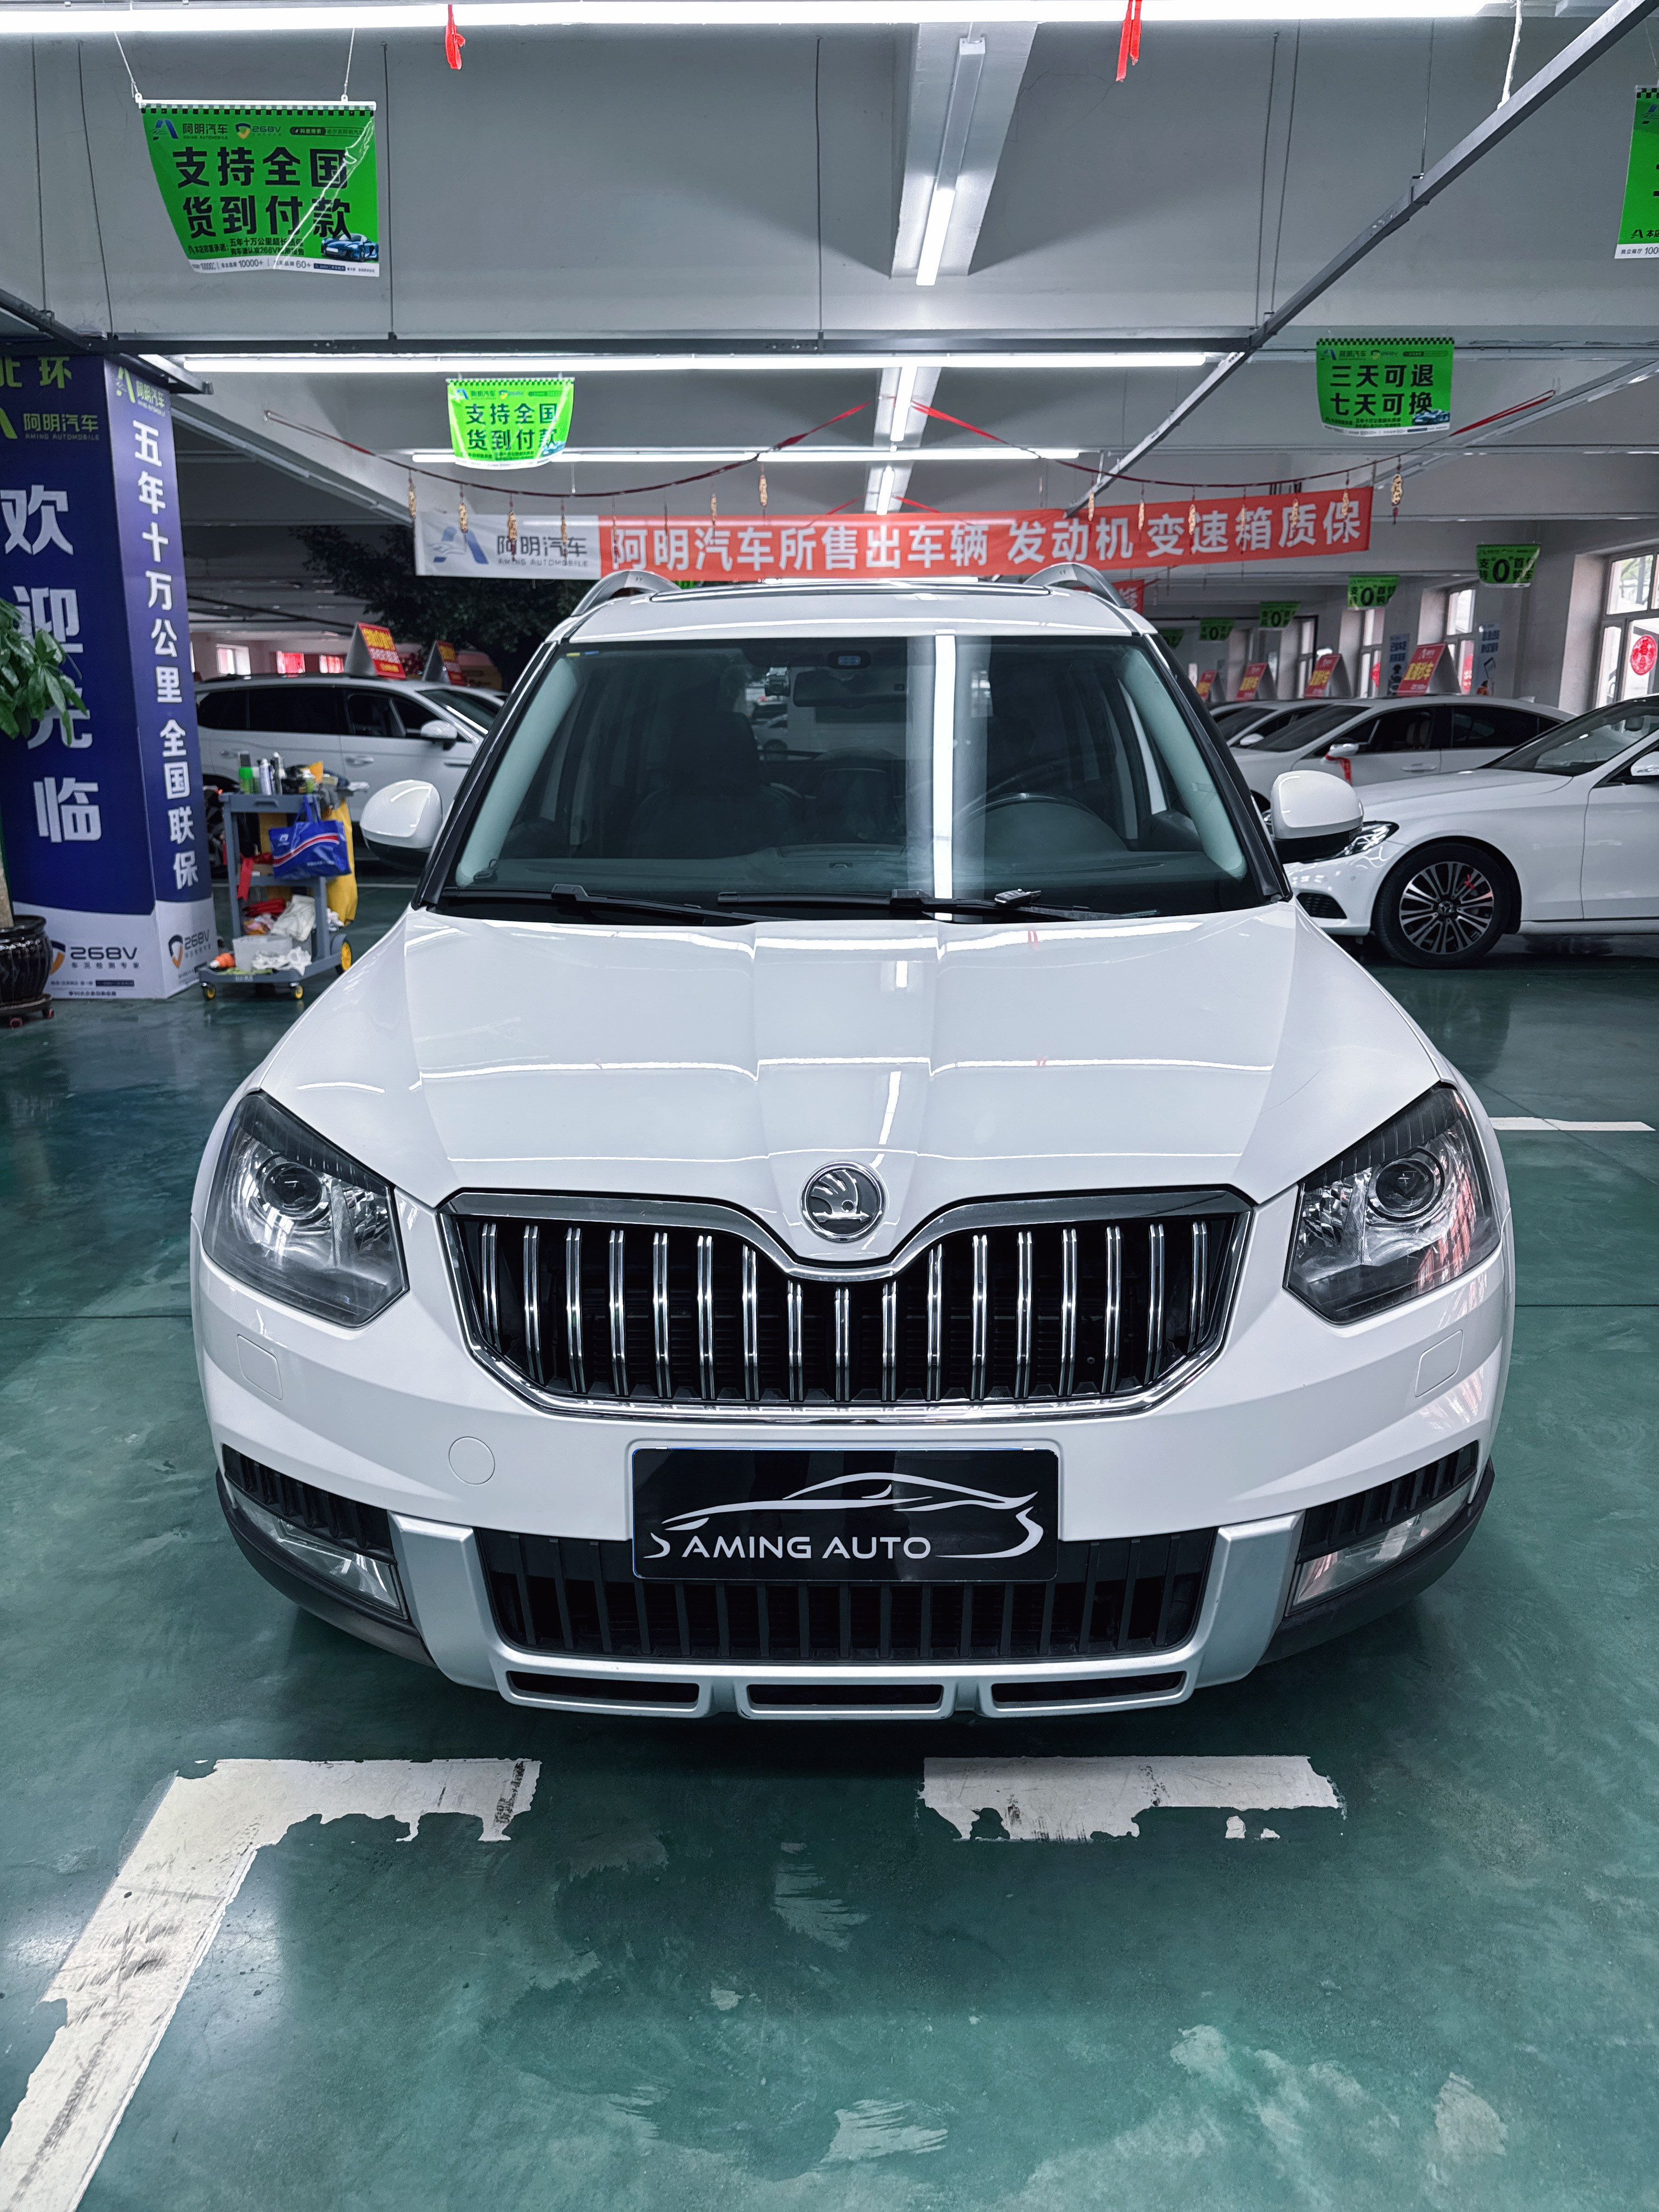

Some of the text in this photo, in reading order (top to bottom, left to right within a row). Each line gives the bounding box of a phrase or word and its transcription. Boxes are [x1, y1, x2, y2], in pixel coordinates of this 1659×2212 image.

[183, 123, 228, 134] 阿明汽车
[172, 146, 349, 189] 支持全国
[182, 195, 352, 239] 货到付款
[239, 258, 263, 268] 10000+
[296, 259, 312, 269] 60+
[1330, 364, 1434, 388] 三天可退
[465, 403, 558, 425] 支持全国
[1330, 391, 1433, 416] 七天可换
[23, 413, 99, 432] 阿明汽车
[466, 428, 558, 451] 货到付款
[498, 535, 588, 557] 阿明汽车
[610, 499, 1361, 572] 阿明汽车所售出车辆 发动机 变速箱质保
[184, 929, 210, 950] 268V
[70, 946, 138, 960] 268V
[681, 1536, 931, 1559] AMING AUTO
